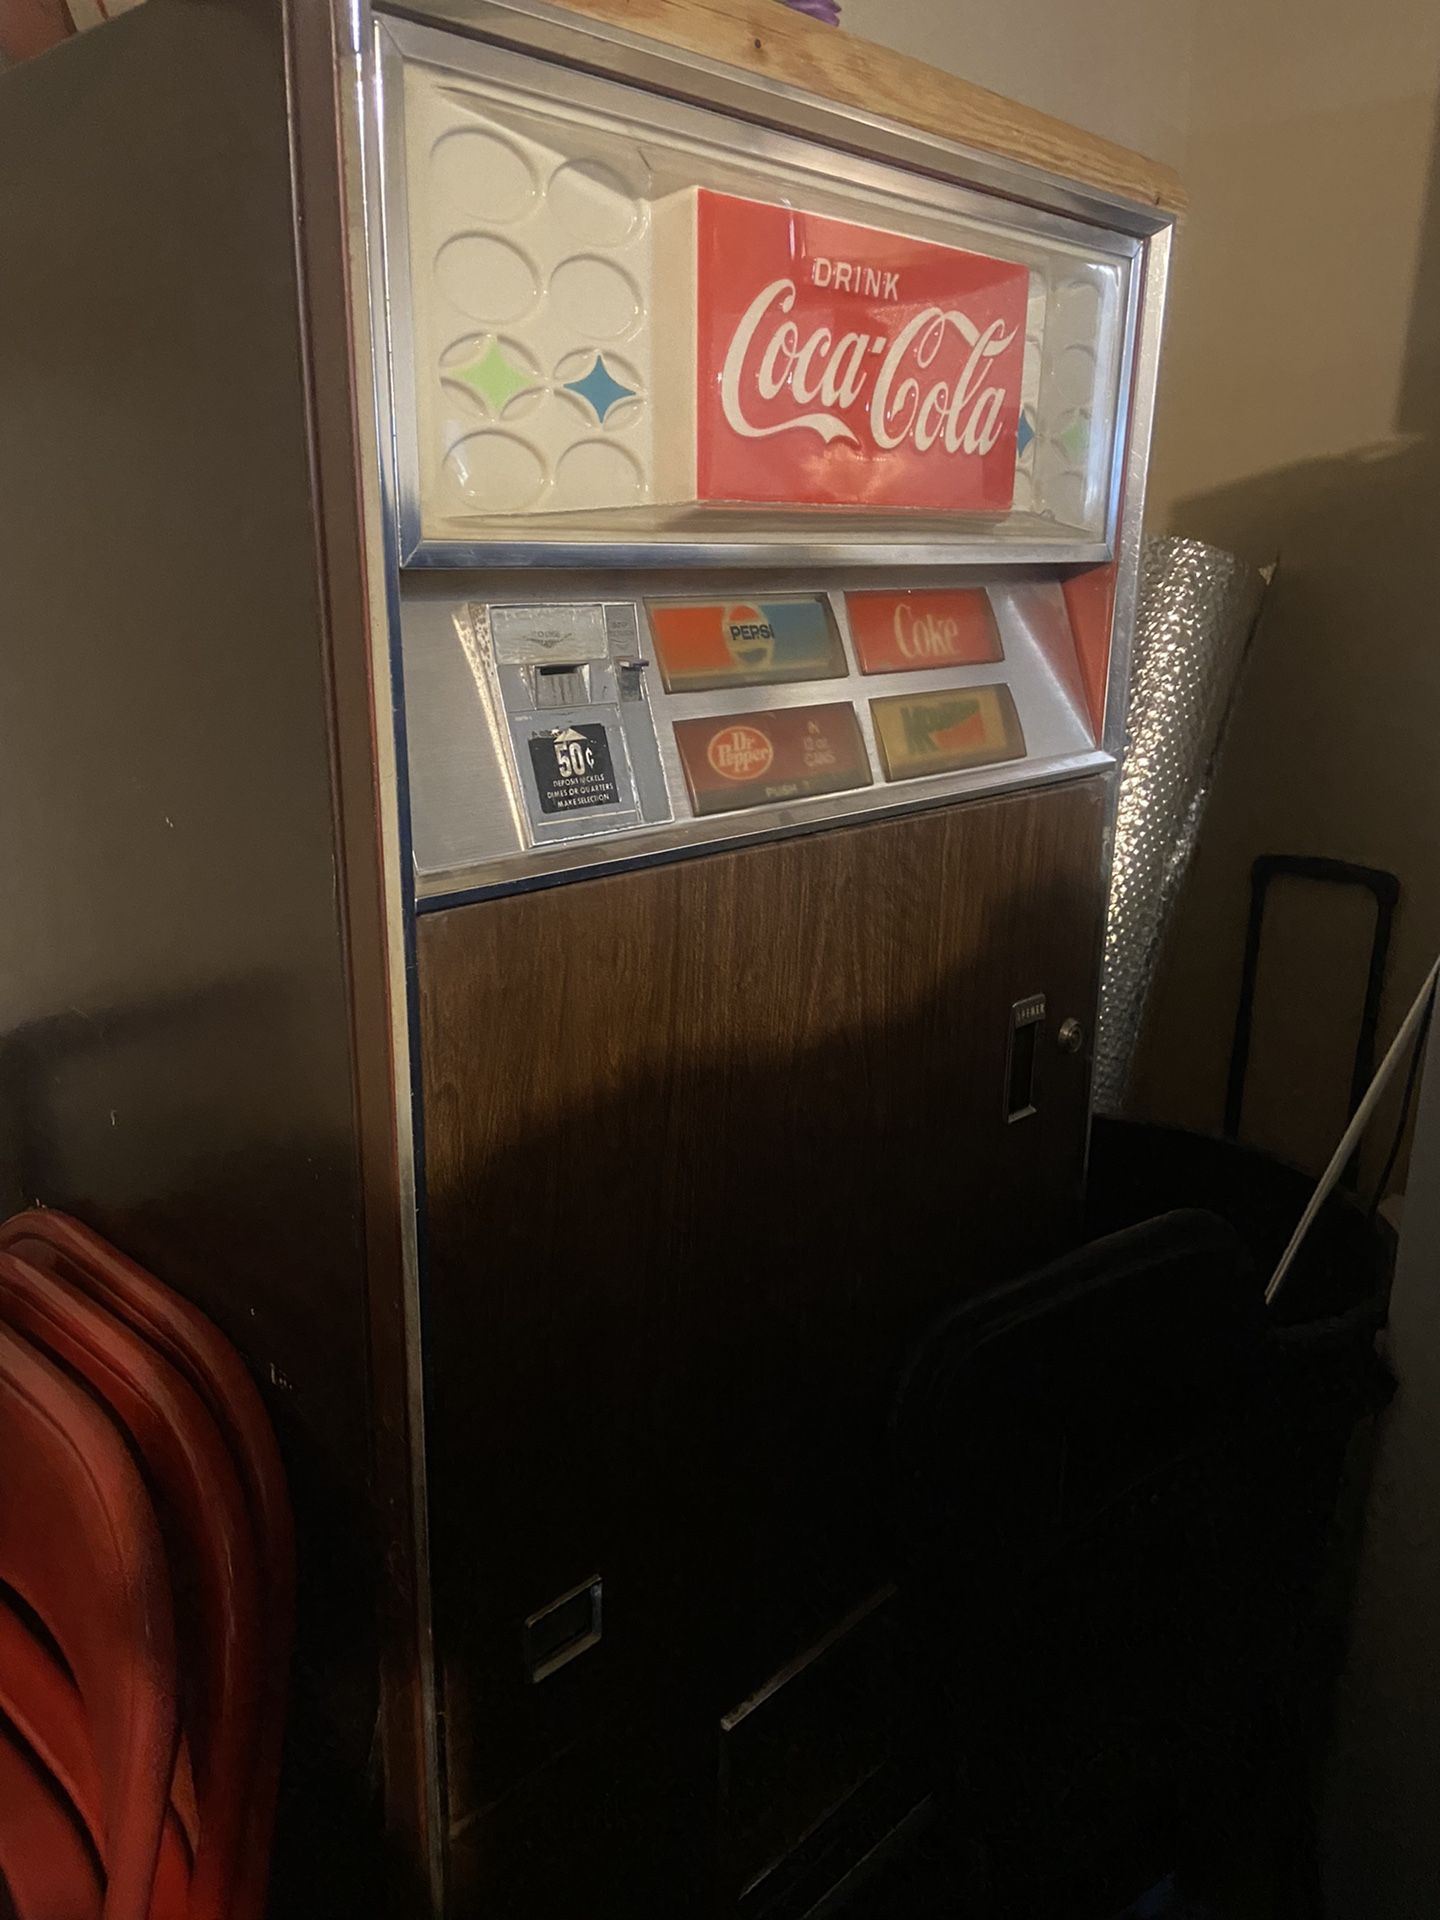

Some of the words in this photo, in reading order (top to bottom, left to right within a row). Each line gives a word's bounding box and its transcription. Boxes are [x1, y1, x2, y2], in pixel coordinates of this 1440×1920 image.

[813, 257, 900, 301] DRINK
[721, 278, 1020, 456] Coca-Cola
[730, 623, 775, 641] PEPSI
[893, 603, 958, 658] Coke
[717, 744, 769, 772] Pepper
[547, 789, 568, 799] DIMES
[569, 788, 579, 796] OR
[580, 782, 614, 794] QUARTERS
[553, 777, 579, 788] DEPOSIT
[557, 799, 577, 809] MAKE
[577, 794, 610, 805] SELECTION
